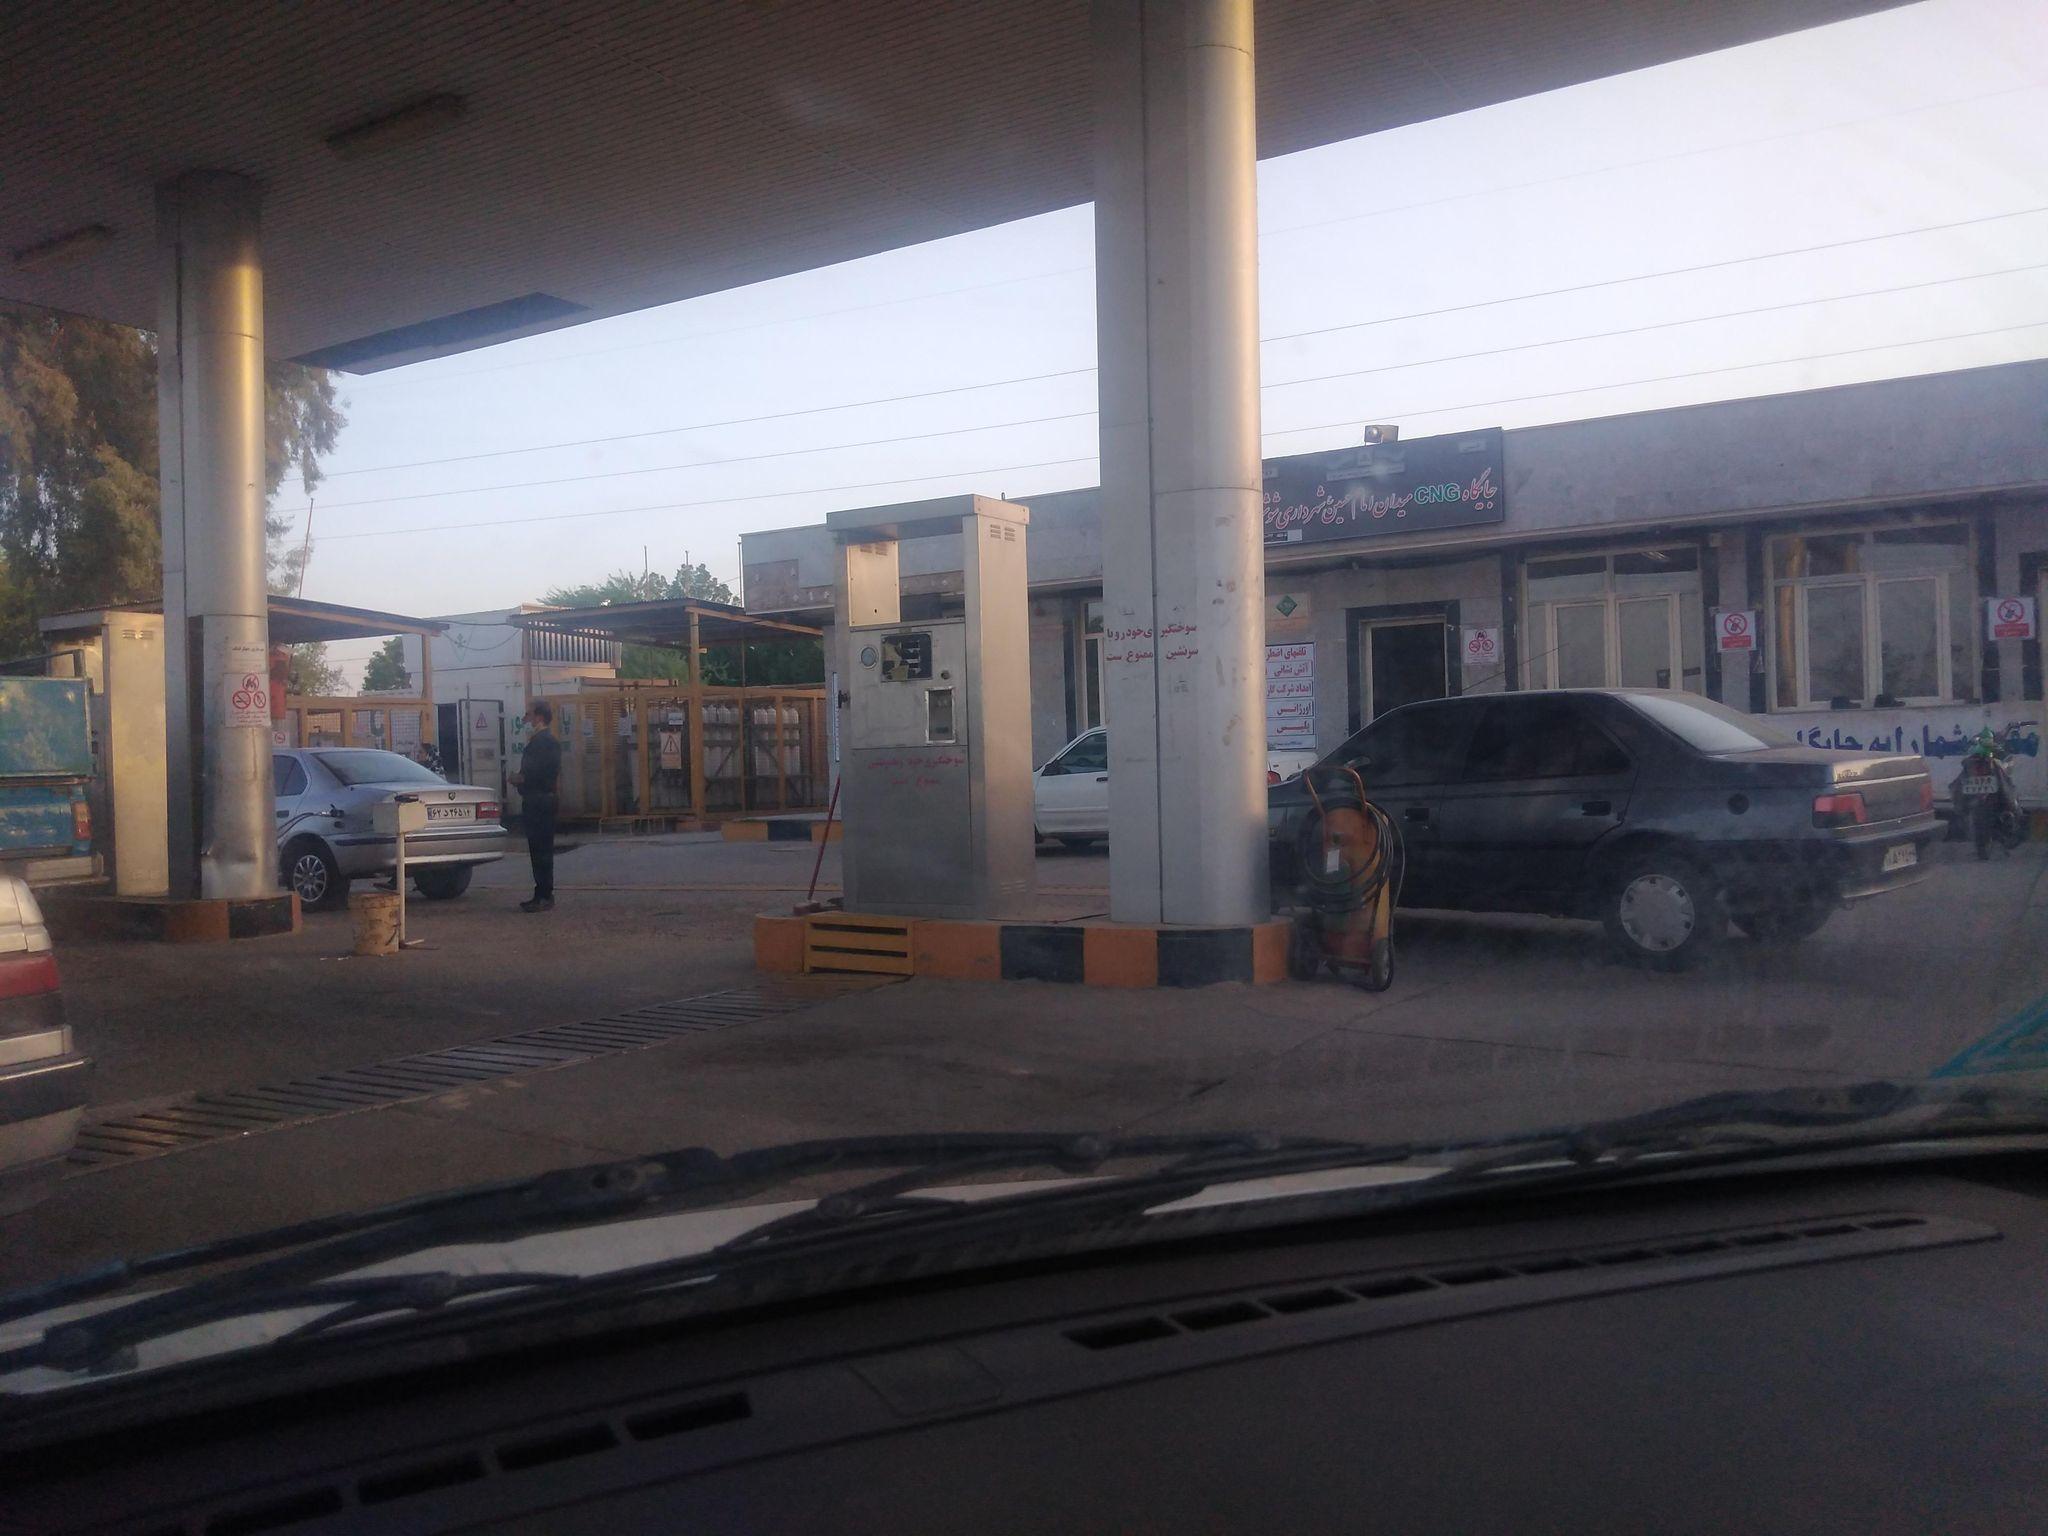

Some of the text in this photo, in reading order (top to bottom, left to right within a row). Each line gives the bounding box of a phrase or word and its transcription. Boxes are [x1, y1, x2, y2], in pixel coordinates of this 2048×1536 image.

[1414, 482, 1461, 504] CNG
[1462, 467, 1498, 510] جایگاه
[1373, 492, 1414, 518] میدان
[1266, 648, 1283, 662] اضطر
